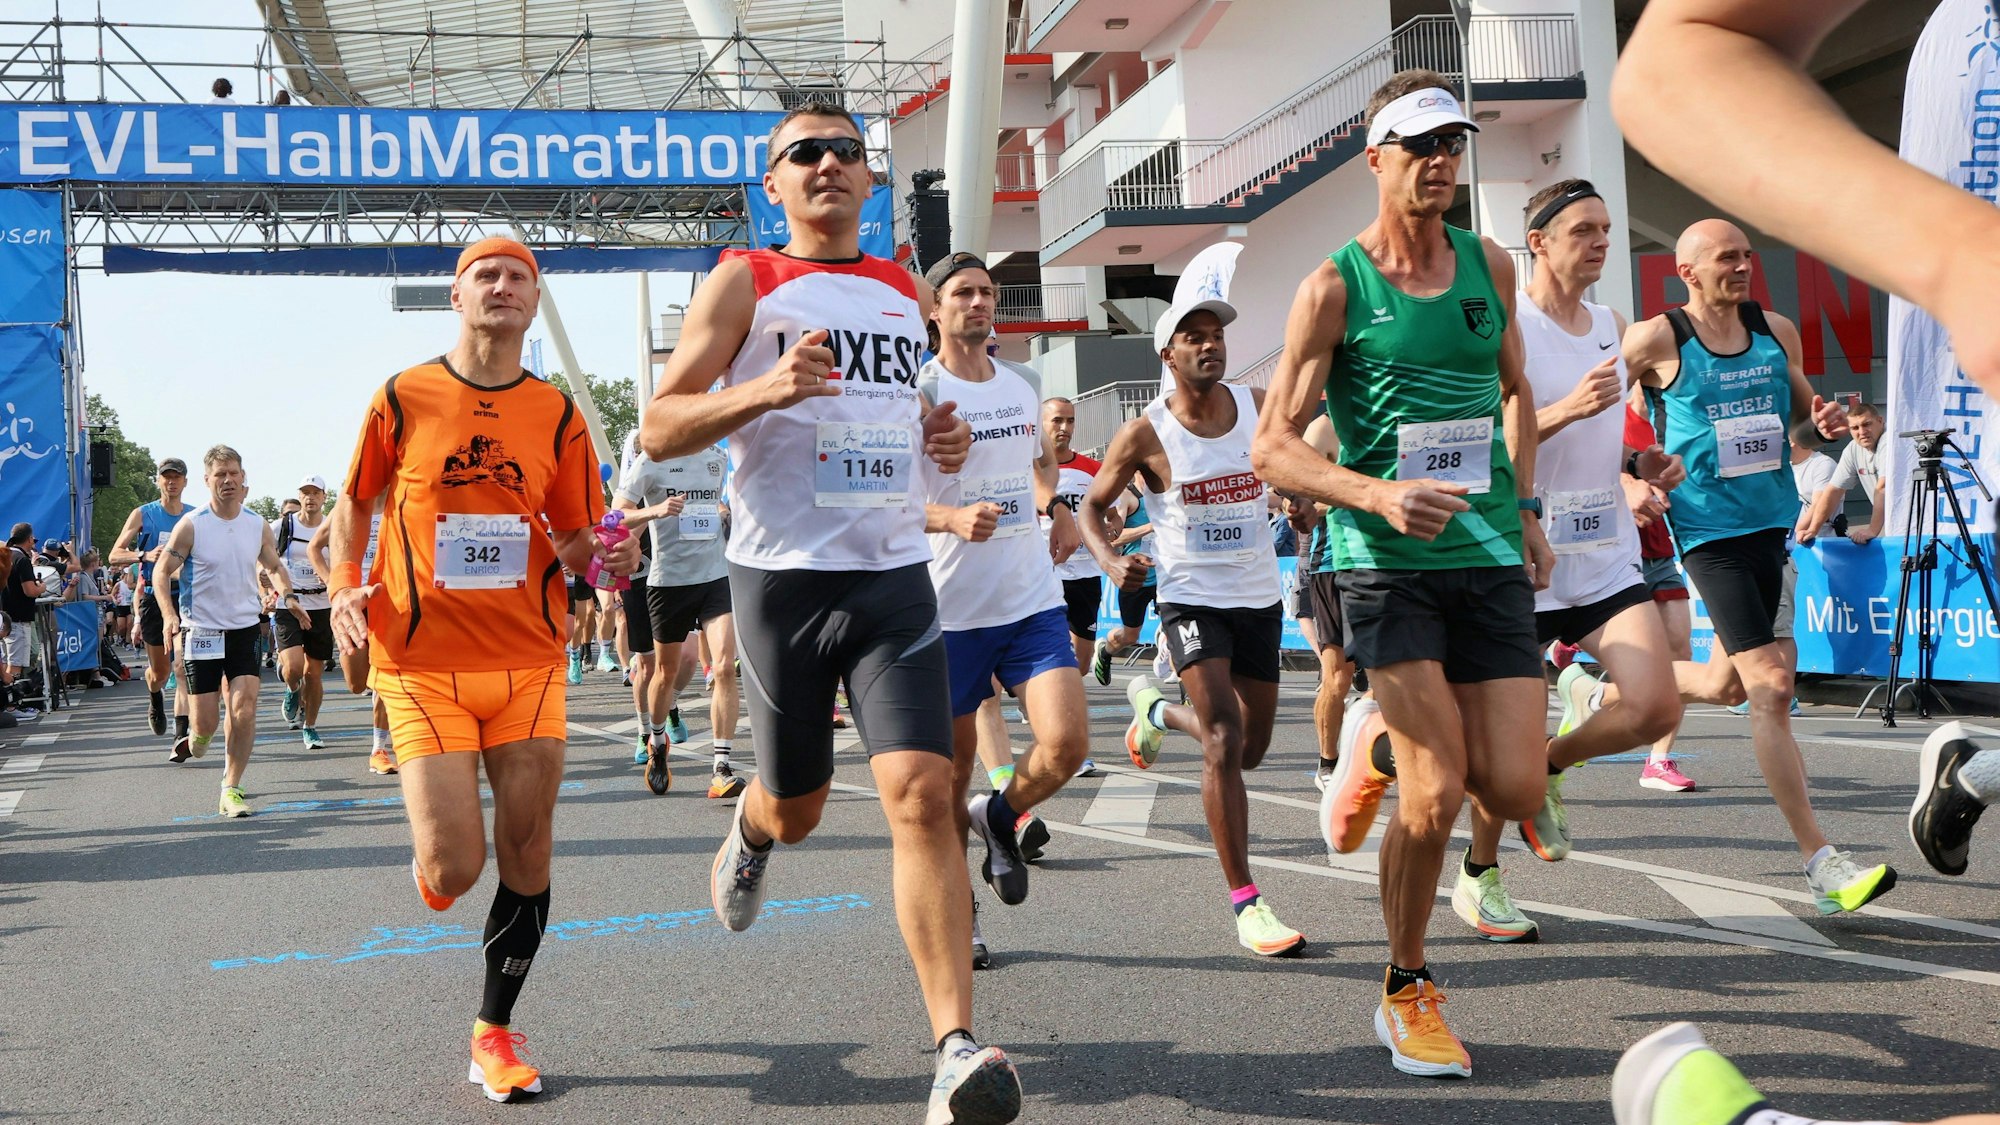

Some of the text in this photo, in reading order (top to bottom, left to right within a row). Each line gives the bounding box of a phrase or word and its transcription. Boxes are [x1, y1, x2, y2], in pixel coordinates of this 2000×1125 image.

[1720, 366, 1772, 382] REFRATH
[845, 387, 894, 399] Energizing
[473, 410, 499, 418] erima
[960, 404, 1025, 424] Vorne dabei
[1705, 395, 1773, 420] ENGELS
[862, 429, 908, 447] 2023
[1440, 424, 1489, 441] 2023
[1735, 439, 1768, 455] 1535
[843, 459, 894, 478] 1146
[1426, 452, 1462, 471] 288
[849, 481, 888, 490] MARTIN
[994, 476, 1028, 494] 2023
[1205, 474, 1254, 493] MILERS
[1207, 485, 1262, 505] COLONIA
[1582, 491, 1615, 508] 2023
[995, 500, 1018, 515] 26
[1217, 505, 1254, 519] 2023
[476, 520, 526, 535] 2023
[694, 519, 709, 528] 193
[1573, 515, 1600, 532] 105
[1203, 527, 1242, 541] 1200
[464, 546, 500, 563] 342
[1202, 541, 1244, 551] BASKARAN
[465, 565, 499, 574] ENRICO
[1806, 596, 1859, 633] Mit
[57, 629, 82, 655] Ziel
[194, 640, 212, 648] 785
